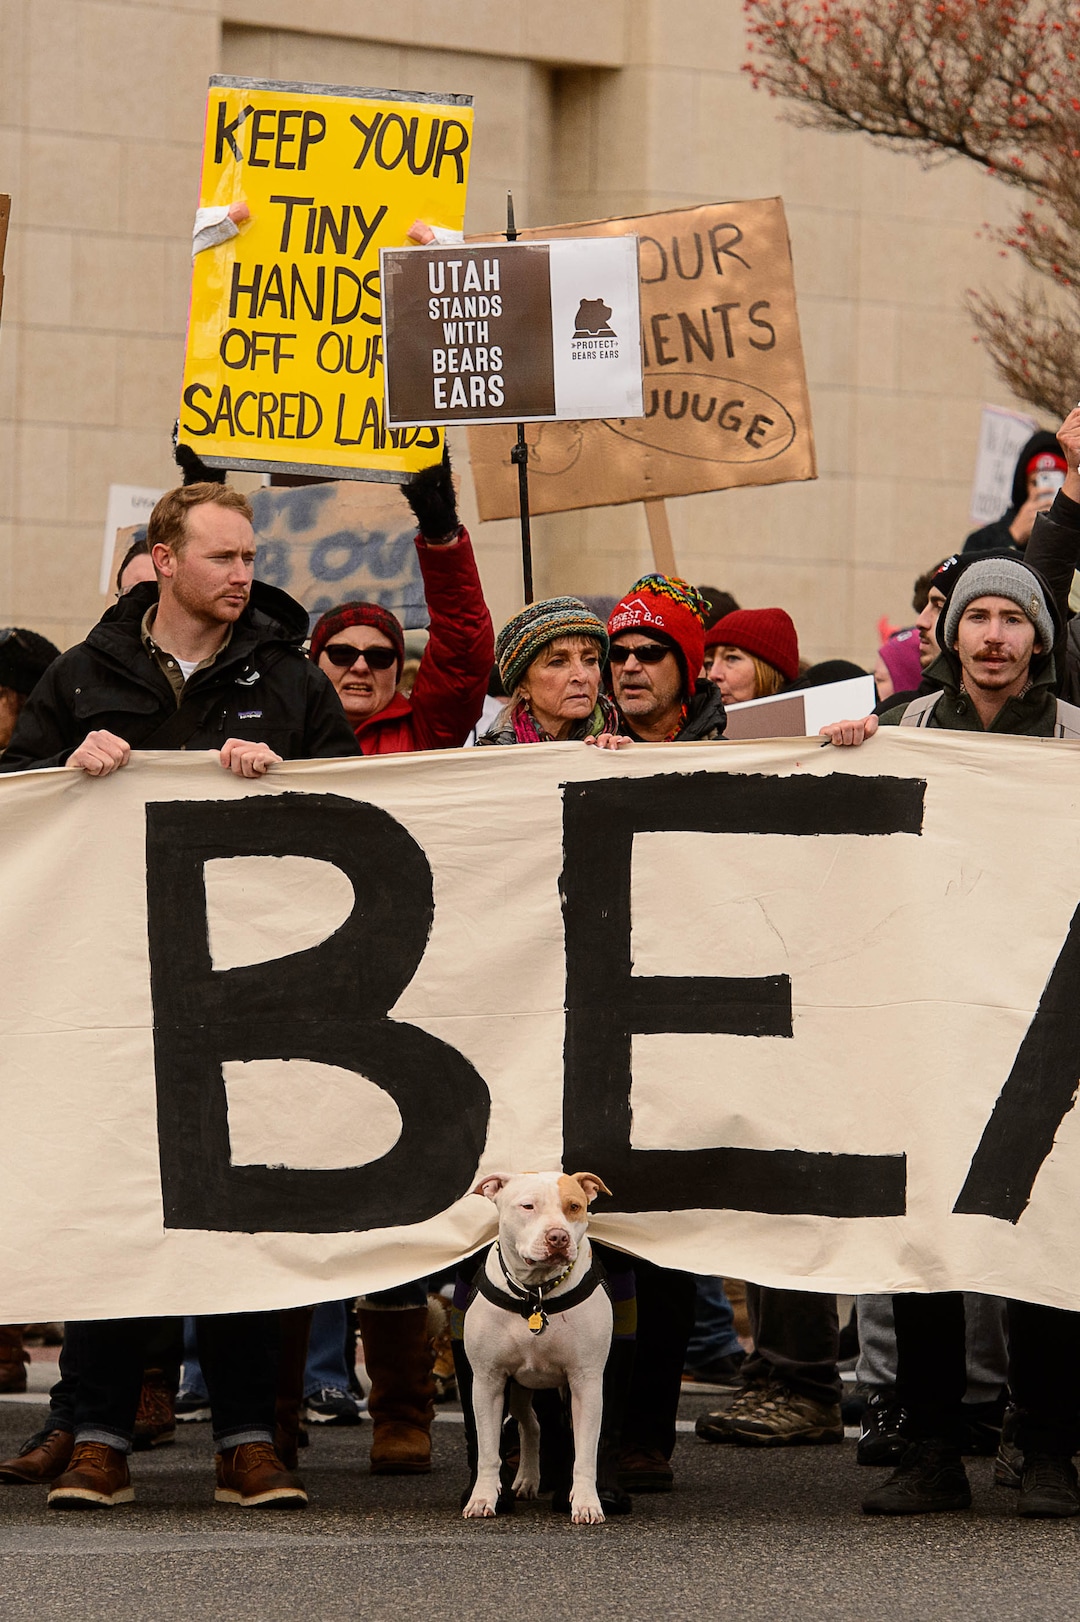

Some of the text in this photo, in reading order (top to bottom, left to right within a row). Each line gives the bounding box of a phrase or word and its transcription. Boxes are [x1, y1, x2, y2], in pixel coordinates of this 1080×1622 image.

[214, 101, 469, 184] KEEP YOUR
[269, 195, 388, 260] TINY
[228, 261, 381, 326] HANDS
[428, 259, 500, 294] UTAH
[428, 295, 503, 320] STANDS
[442, 321, 489, 345] WITH
[576, 340, 614, 350] PROTECT
[642, 300, 776, 368] ENTS
[219, 328, 297, 374] OFF
[432, 346, 503, 374] BEARS
[571, 350, 619, 360] BEARS EARS
[433, 375, 505, 409] EARS
[183, 382, 323, 440] SACRED
